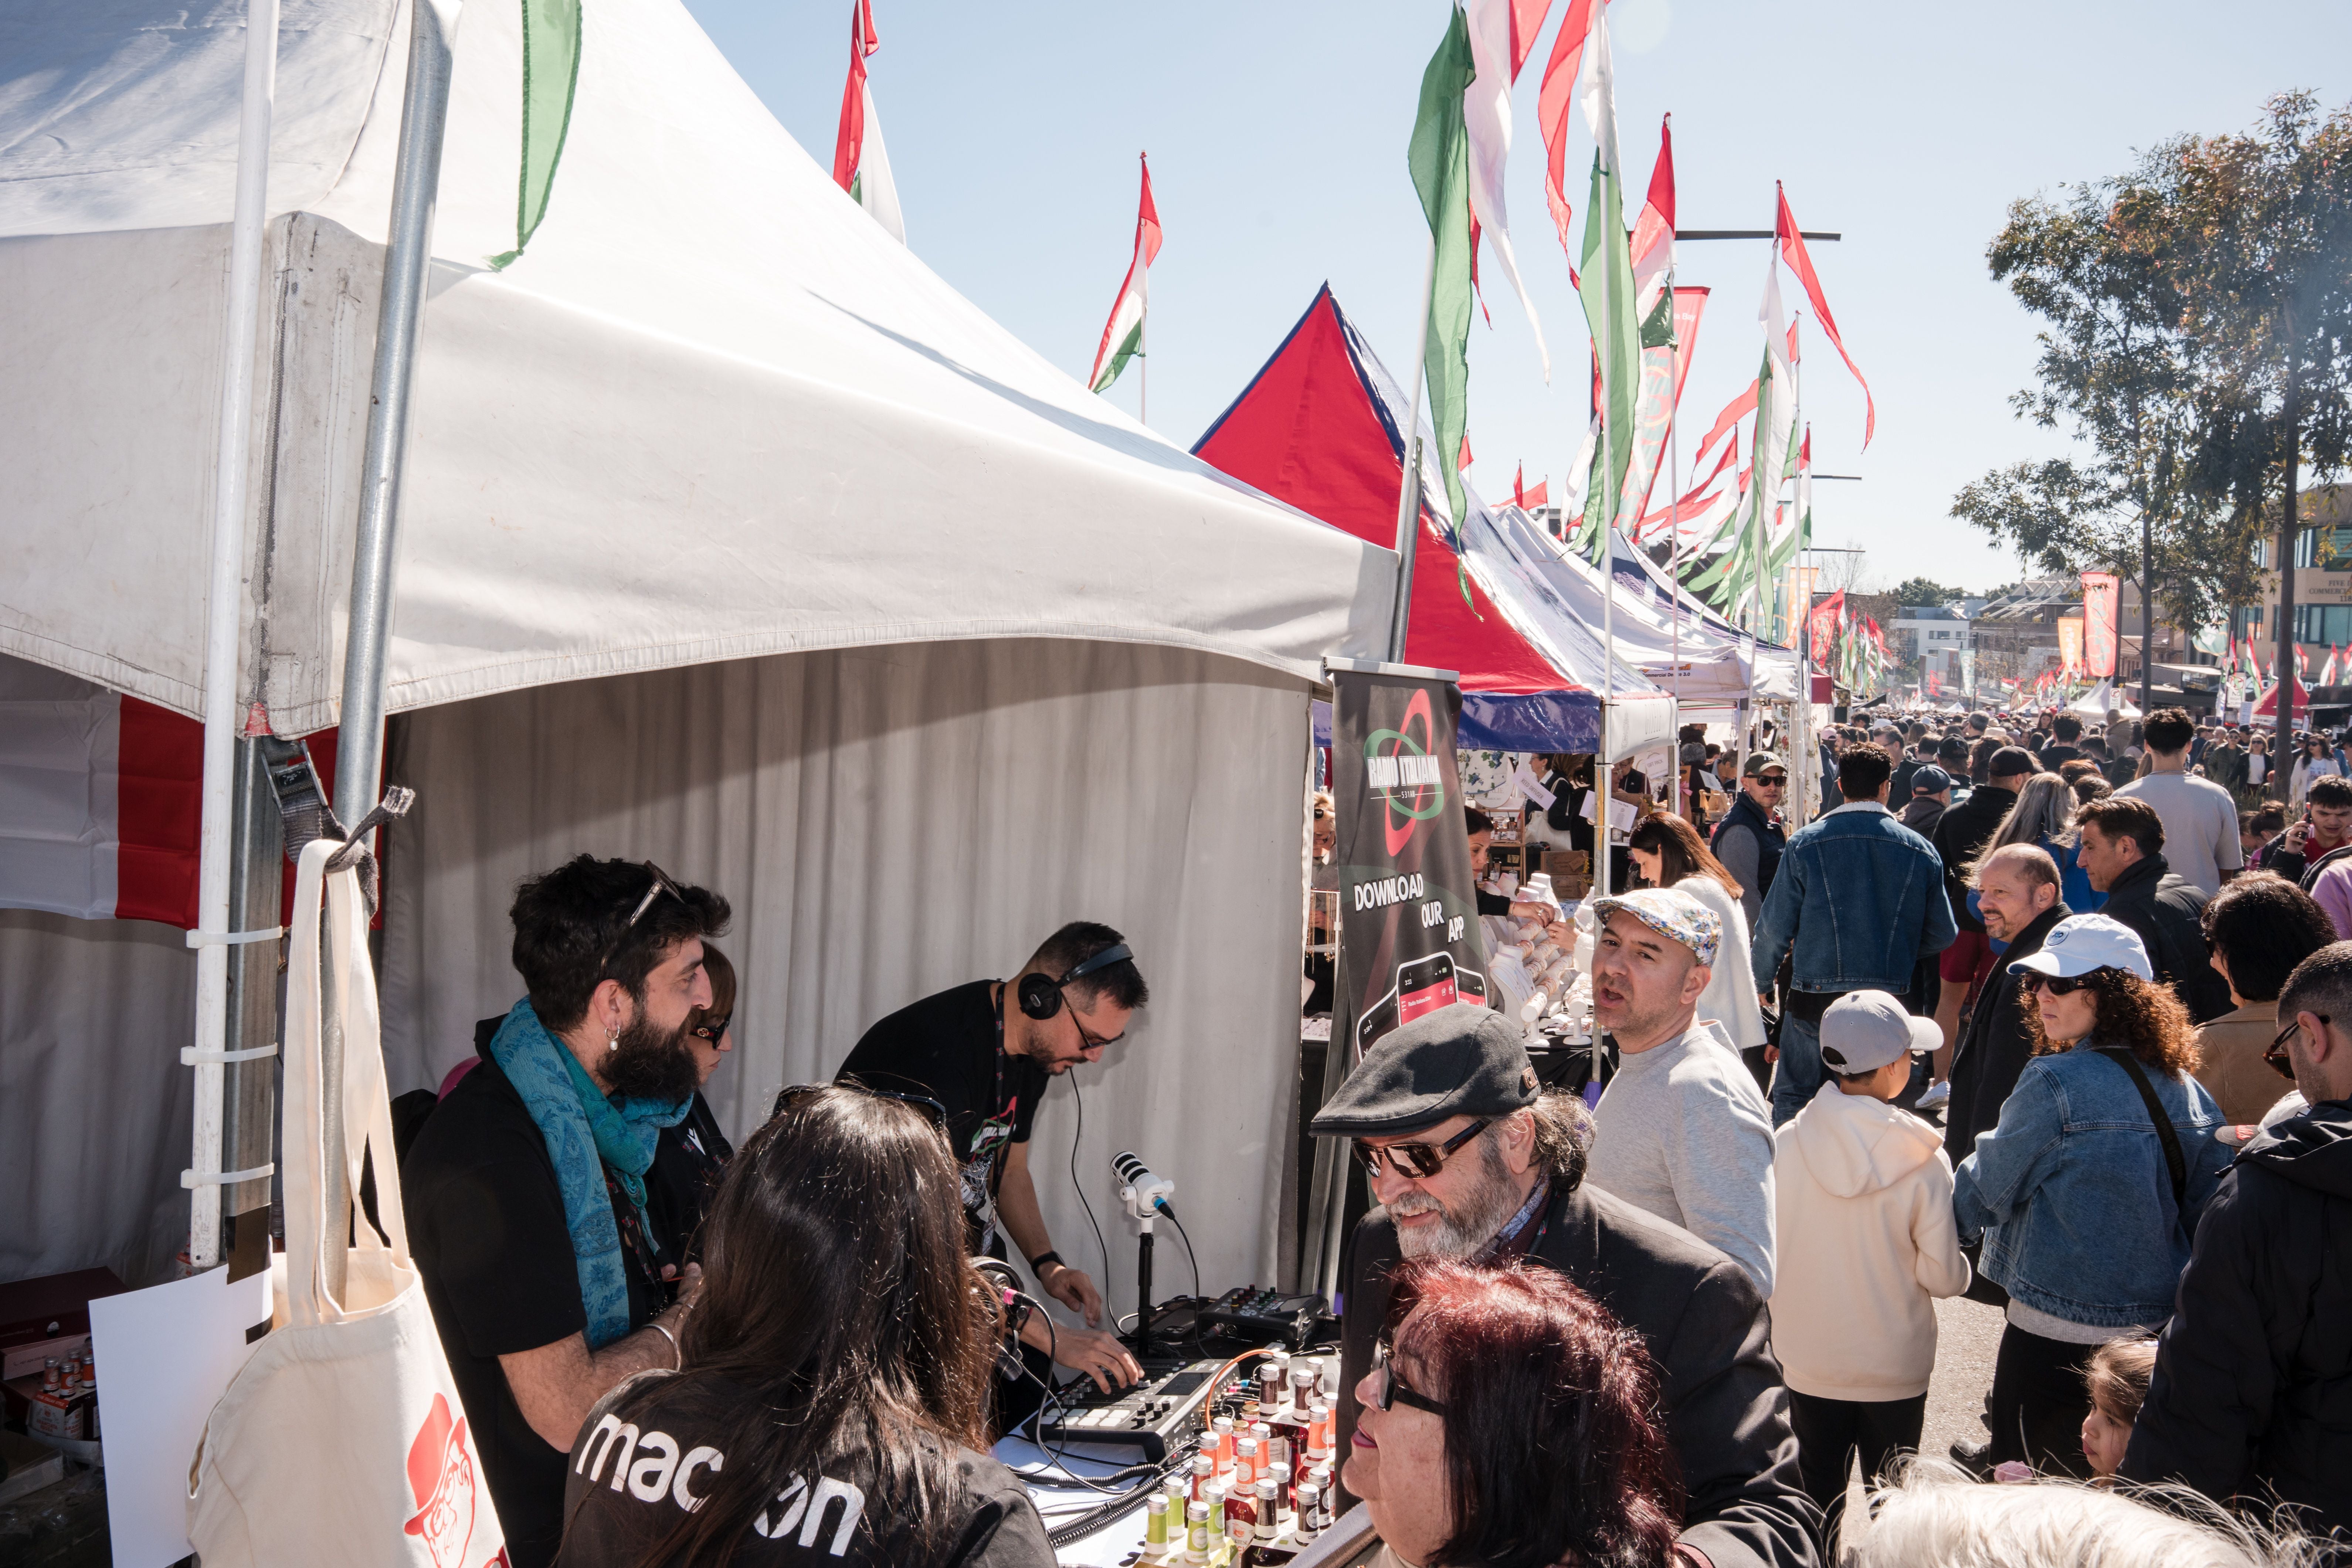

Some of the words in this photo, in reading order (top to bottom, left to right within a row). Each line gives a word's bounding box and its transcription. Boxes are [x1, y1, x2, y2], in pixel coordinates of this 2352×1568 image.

[1682, 313, 1696, 322] Bay
[1367, 756, 1399, 788] RADIO
[1398, 755, 1442, 786] ITALIANA
[1401, 790, 1415, 798] 531AM
[1521, 778, 1530, 787] REED
[1528, 785, 1544, 799] DIFFUSER
[1354, 873, 1423, 912] DOWNLOAD
[1421, 900, 1445, 929] OUR
[1448, 915, 1464, 943] APP
[575, 1413, 865, 1557] macon
